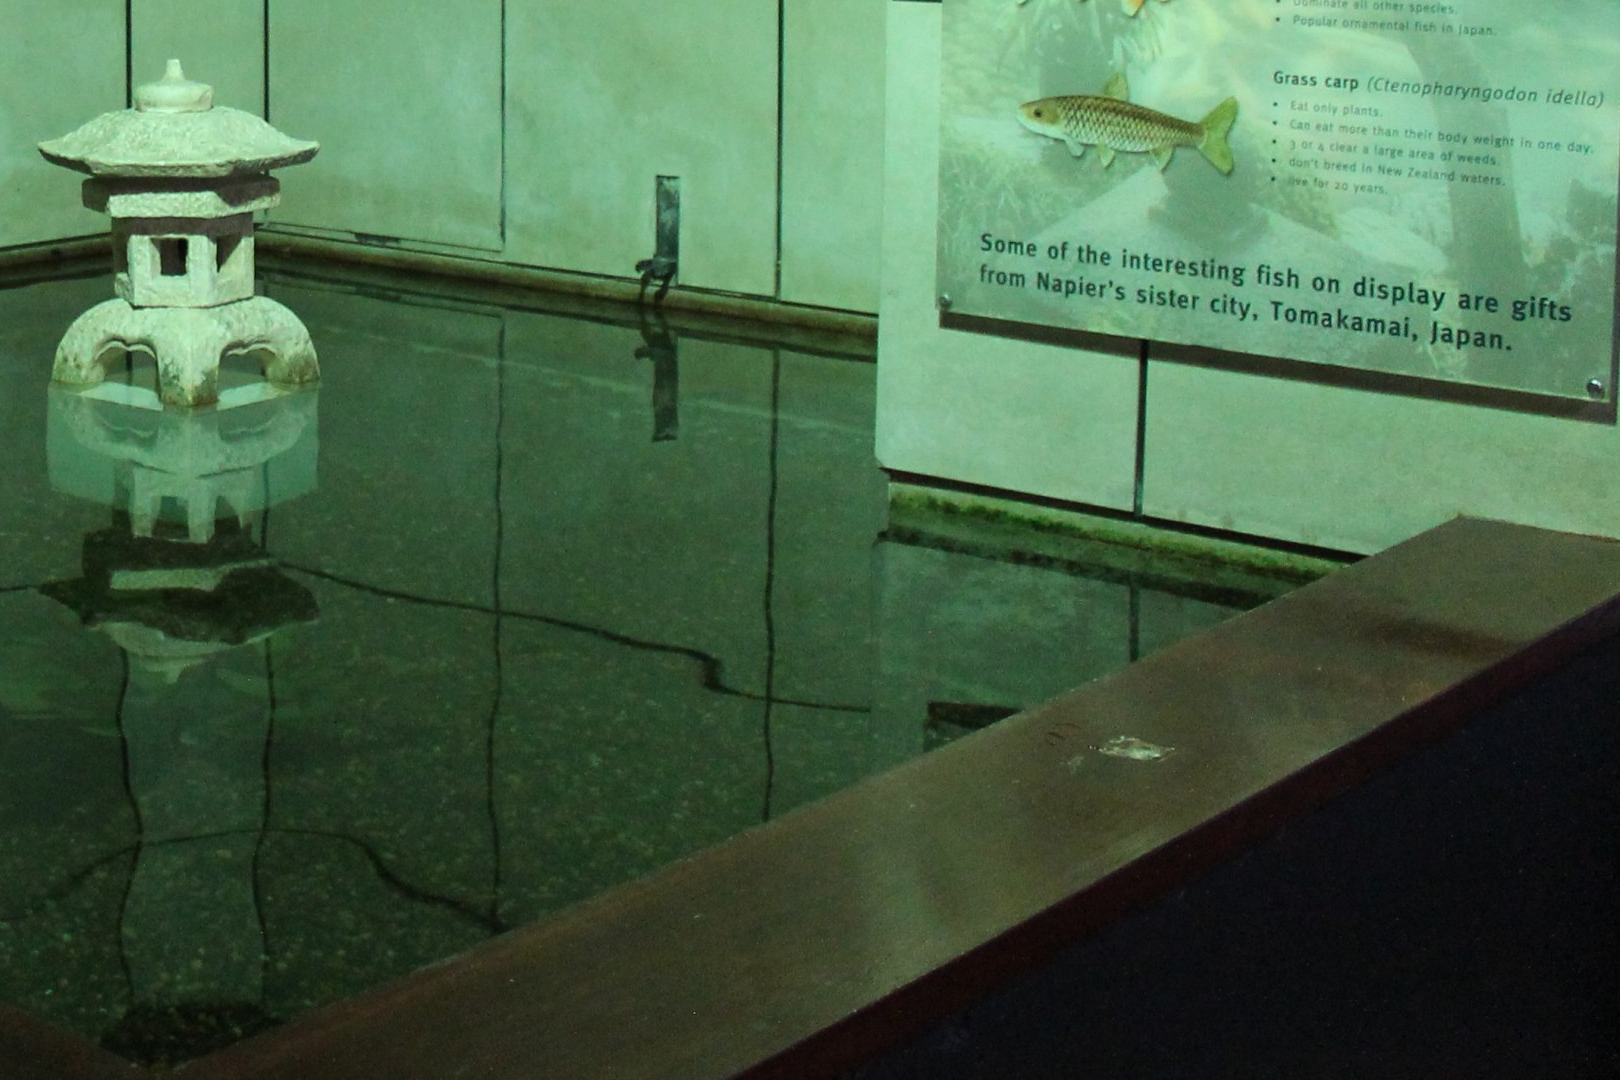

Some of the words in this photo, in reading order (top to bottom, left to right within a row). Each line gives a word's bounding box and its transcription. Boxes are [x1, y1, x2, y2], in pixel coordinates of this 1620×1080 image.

[1352, 0, 1368, 9] all
[1372, 0, 1404, 11] other
[1292, 14, 1338, 27] Popular
[1340, 19, 1410, 31] ornamental
[1412, 20, 1438, 32] fish
[1458, 25, 1498, 36] Japan.
[1272, 70, 1318, 87] Grass
[1322, 76, 1360, 92] carp
[1366, 77, 1538, 102] (Ctenopharyngodon
[1544, 88, 1606, 107] idella)
[1289, 99, 1308, 111] Eat
[1312, 103, 1338, 115] only
[1341, 104, 1384, 117] plants.
[1288, 118, 1311, 130] Can
[1314, 122, 1334, 132] eat
[1337, 124, 1368, 135] more
[1371, 125, 1400, 137] than
[1402, 128, 1433, 139] their
[1436, 130, 1468, 144] body
[1472, 134, 1515, 148] weight
[1536, 140, 1562, 151] one
[1566, 140, 1595, 155] day.
[1288, 140, 1296, 150] 3
[1300, 141, 1313, 149] or
[1316, 143, 1325, 152] 4
[1328, 143, 1358, 153] clear
[1361, 145, 1370, 154] a
[1372, 144, 1404, 159] large
[1407, 149, 1436, 160] area
[1439, 150, 1454, 161] of
[1456, 154, 1501, 165] weeds.
[1322, 159, 1358, 172] breed
[1376, 164, 1403, 176] New
[1406, 166, 1456, 181] Zealand
[1458, 174, 1507, 185] waters.
[1312, 176, 1329, 188] for
[1333, 181, 1349, 191] 20
[1352, 184, 1389, 194] years.
[979, 232, 1038, 257] Some
[1046, 241, 1069, 260] of
[1076, 244, 1112, 266] the
[1120, 249, 1246, 286] interesting
[1255, 265, 1300, 289] fish
[1310, 276, 1340, 293] on
[1352, 277, 1446, 310] display
[1457, 293, 1499, 313] are
[1510, 297, 1573, 322] gifts
[978, 263, 1026, 286] from
[1135, 285, 1200, 309] sister
[1208, 294, 1258, 321] city,
[1269, 301, 1418, 340] Tomakamai,
[1430, 321, 1513, 350] Japan.
